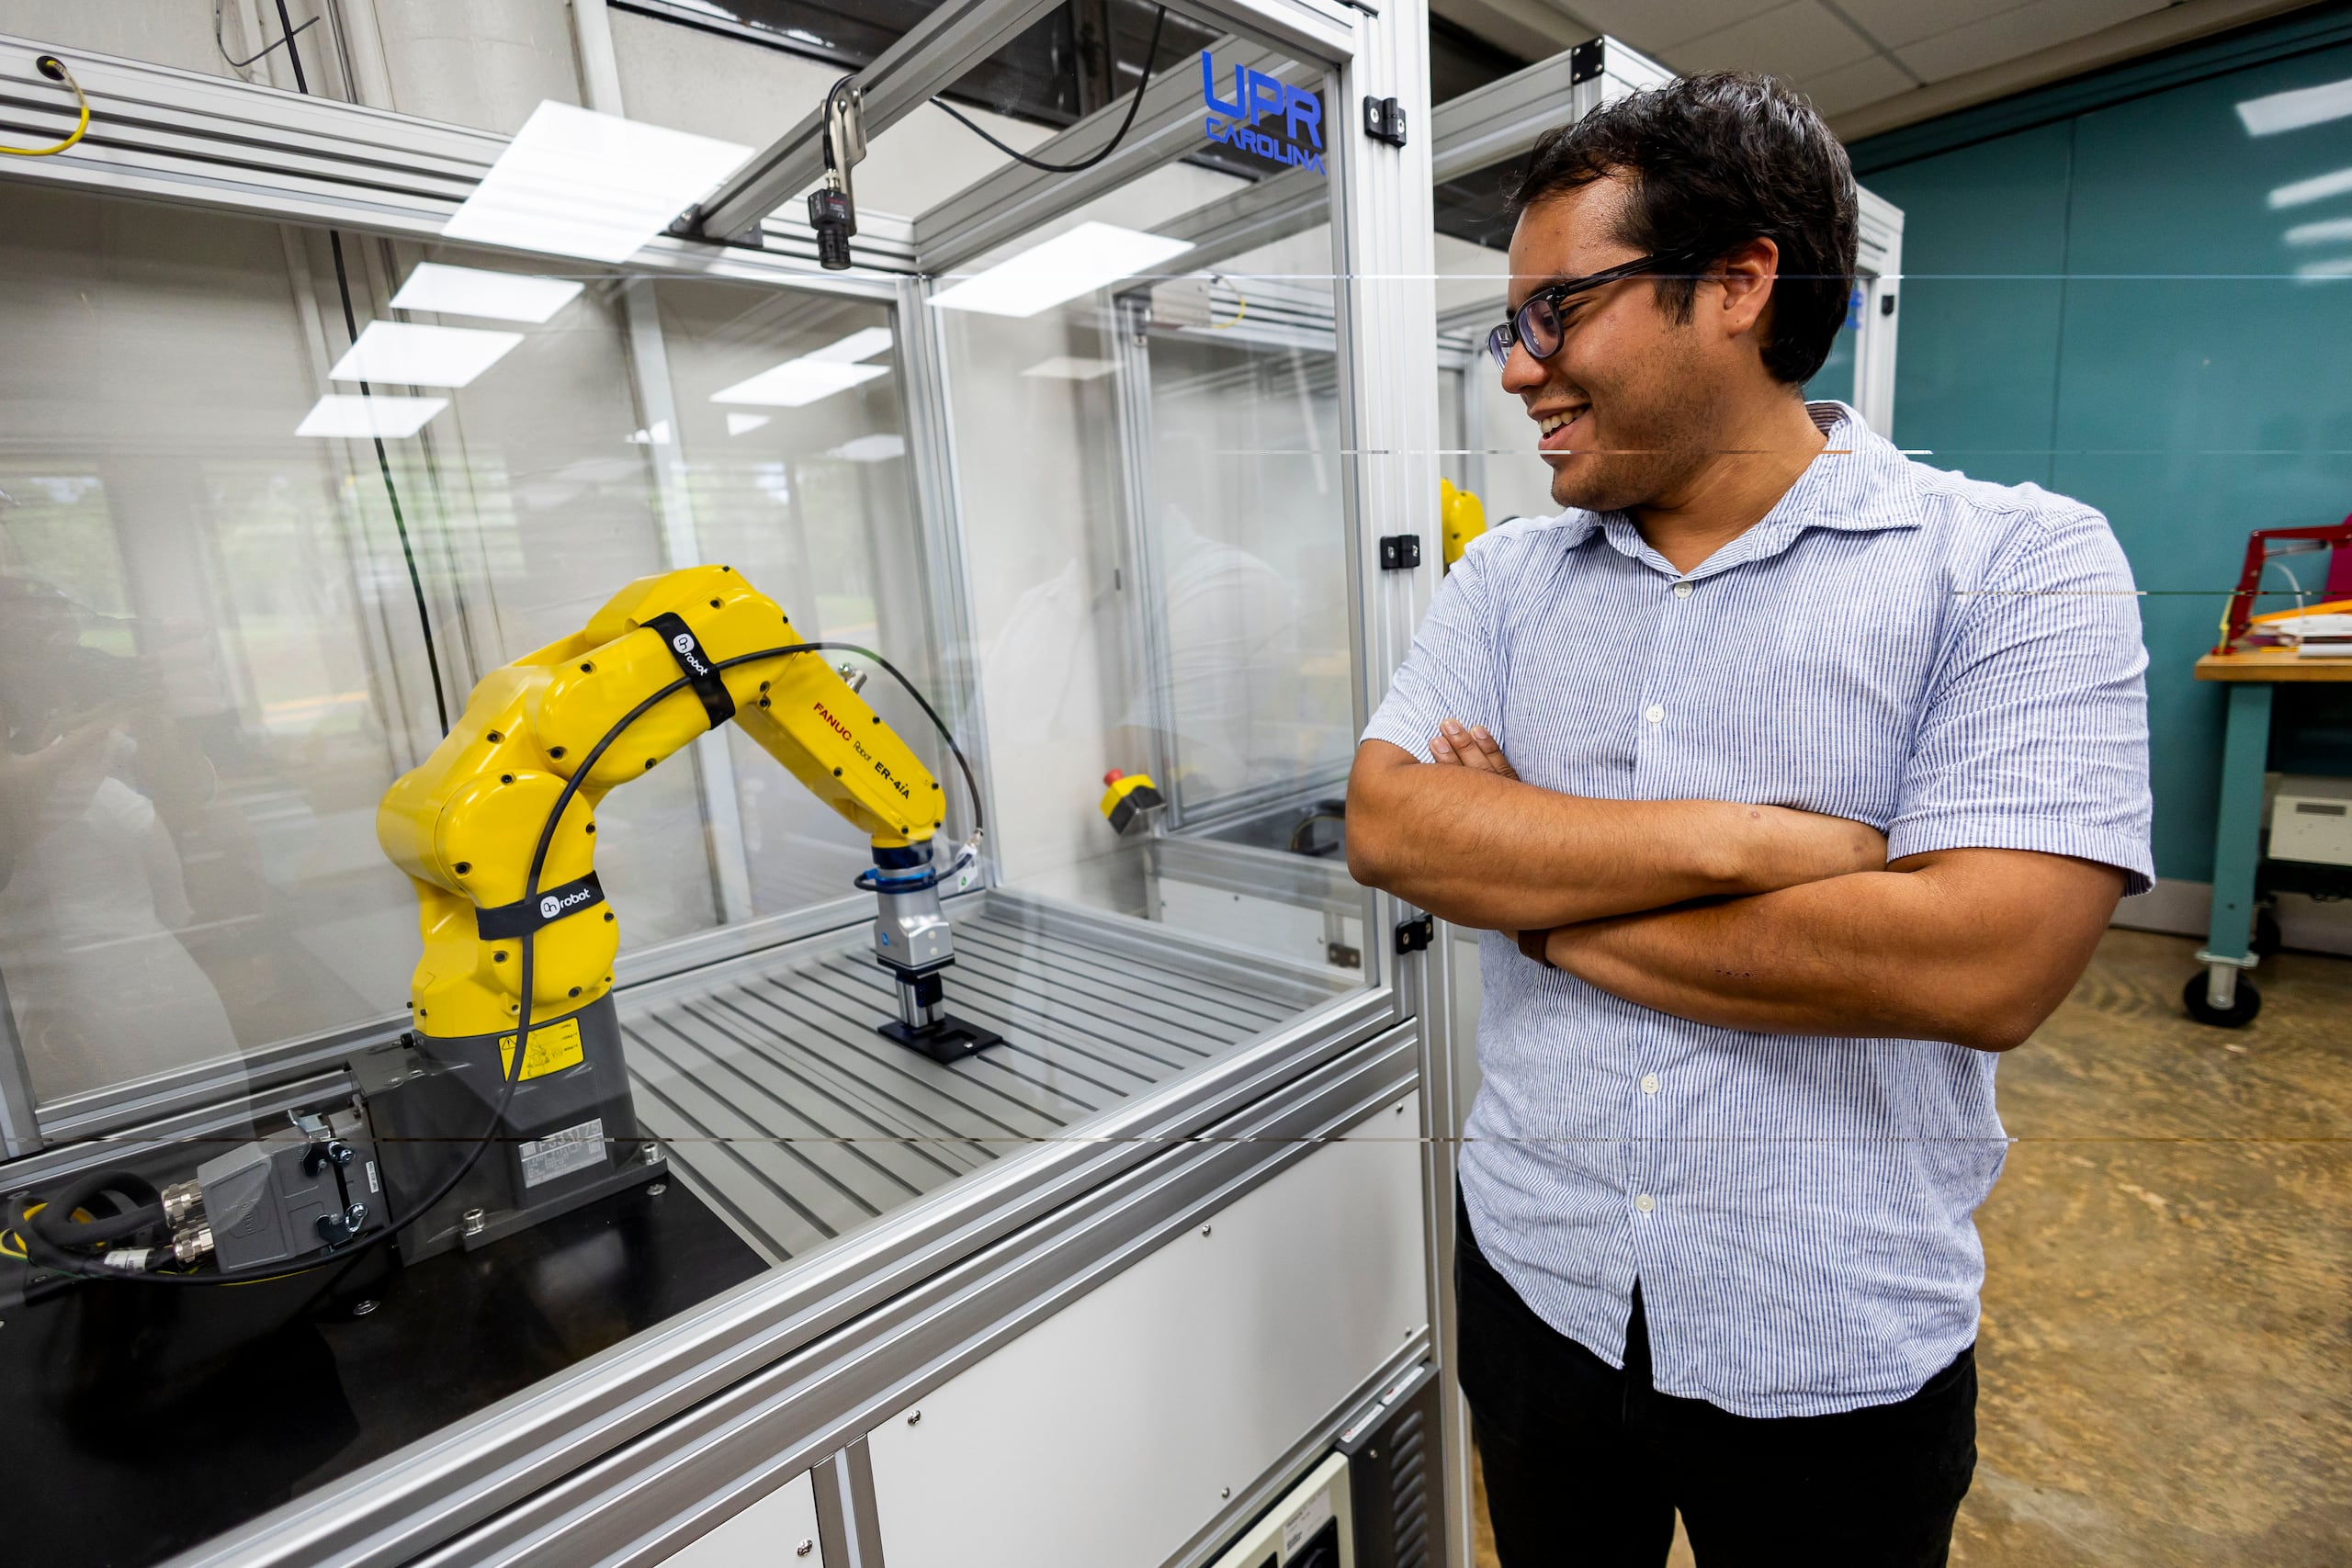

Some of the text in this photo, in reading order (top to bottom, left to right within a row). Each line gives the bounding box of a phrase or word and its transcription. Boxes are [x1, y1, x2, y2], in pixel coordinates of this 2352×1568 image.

[1202, 50, 1323, 149] UPR
[1205, 117, 1327, 176] CAROLINA
[813, 702, 853, 741] FANUC
